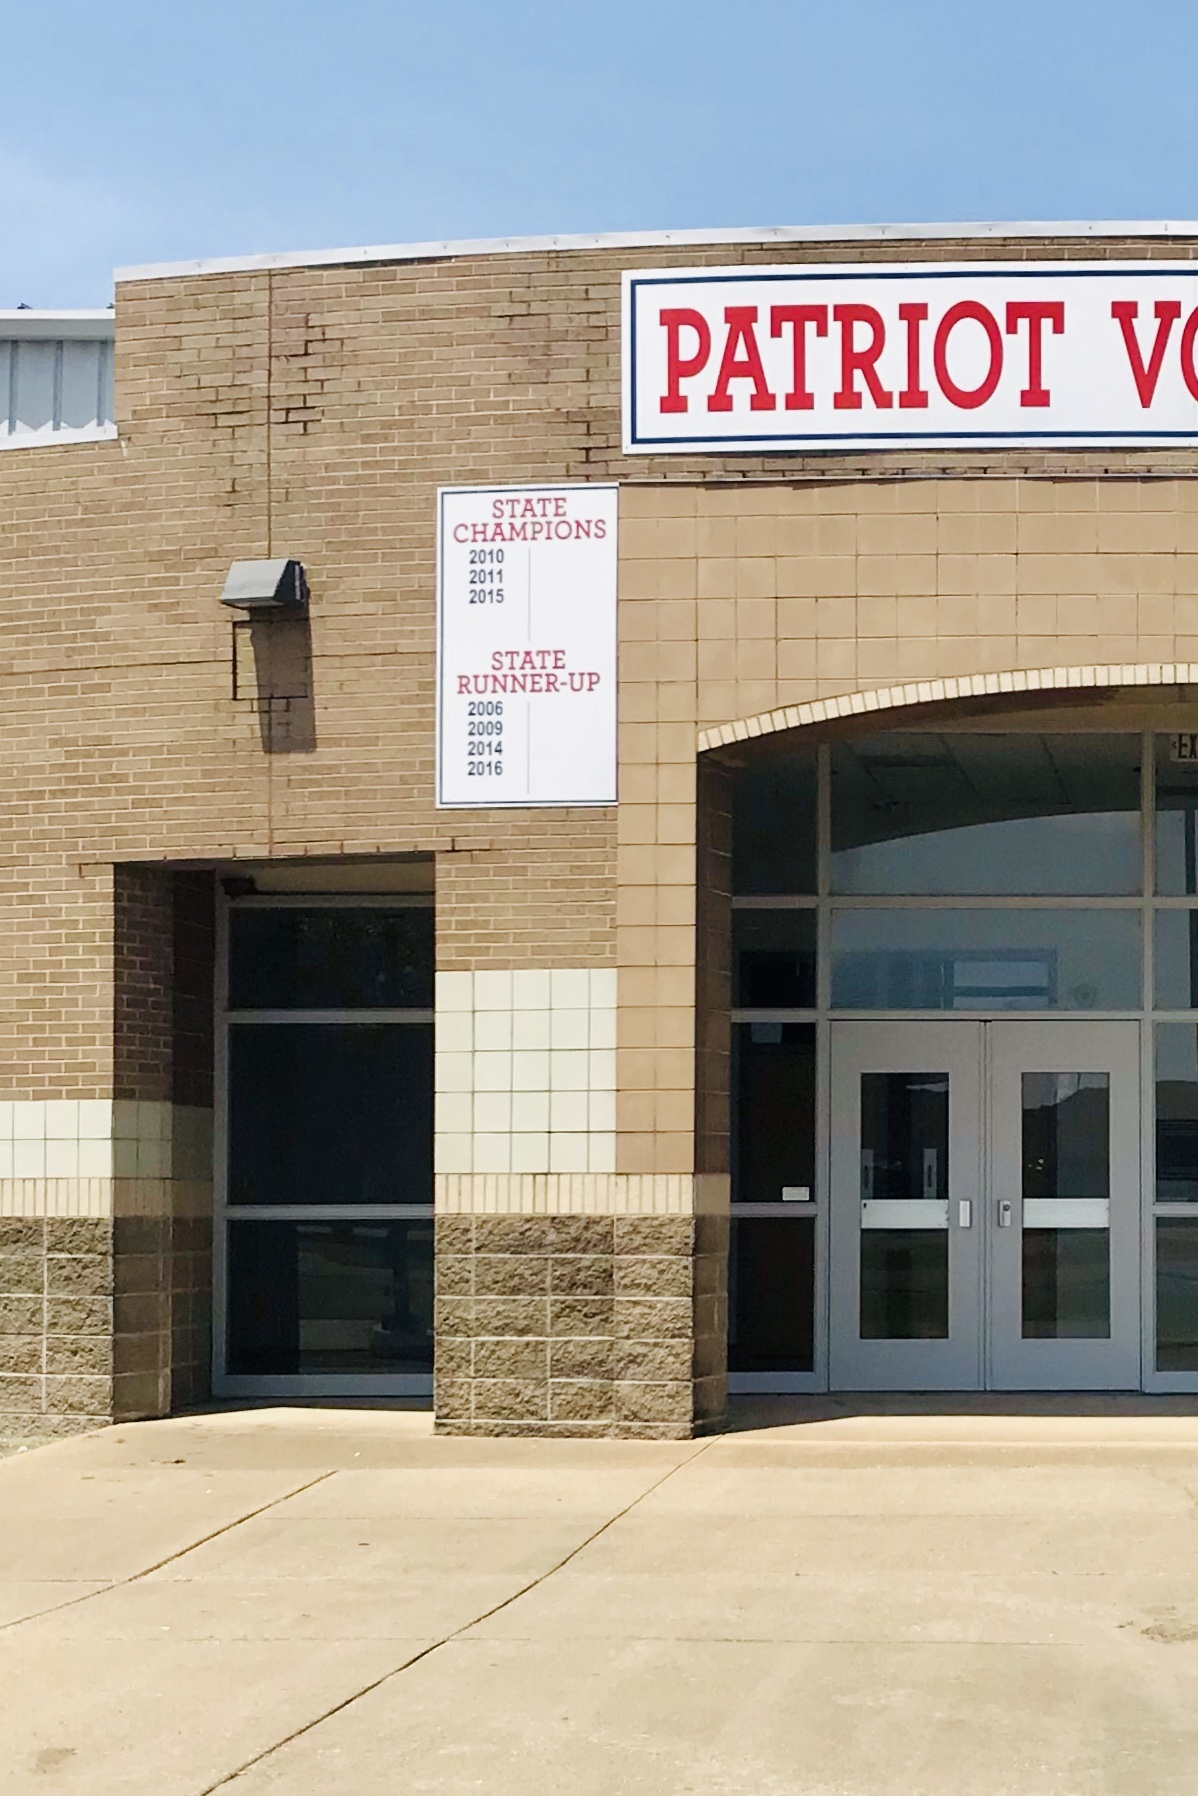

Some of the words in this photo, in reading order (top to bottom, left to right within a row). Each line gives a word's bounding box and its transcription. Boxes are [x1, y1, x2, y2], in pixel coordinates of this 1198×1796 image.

[659, 300, 1064, 413] PATRIOT
[493, 498, 566, 518] STATE
[454, 519, 605, 543] CHAMPIONS
[470, 549, 503, 564] 2010
[470, 569, 502, 584] 2011
[470, 589, 503, 603] 2015
[492, 650, 565, 670] STATE
[458, 673, 600, 694] RUNNER-UP
[468, 701, 502, 716] 2006
[468, 721, 502, 736] 2009
[468, 741, 502, 756] 2014
[468, 761, 502, 775] 2016
